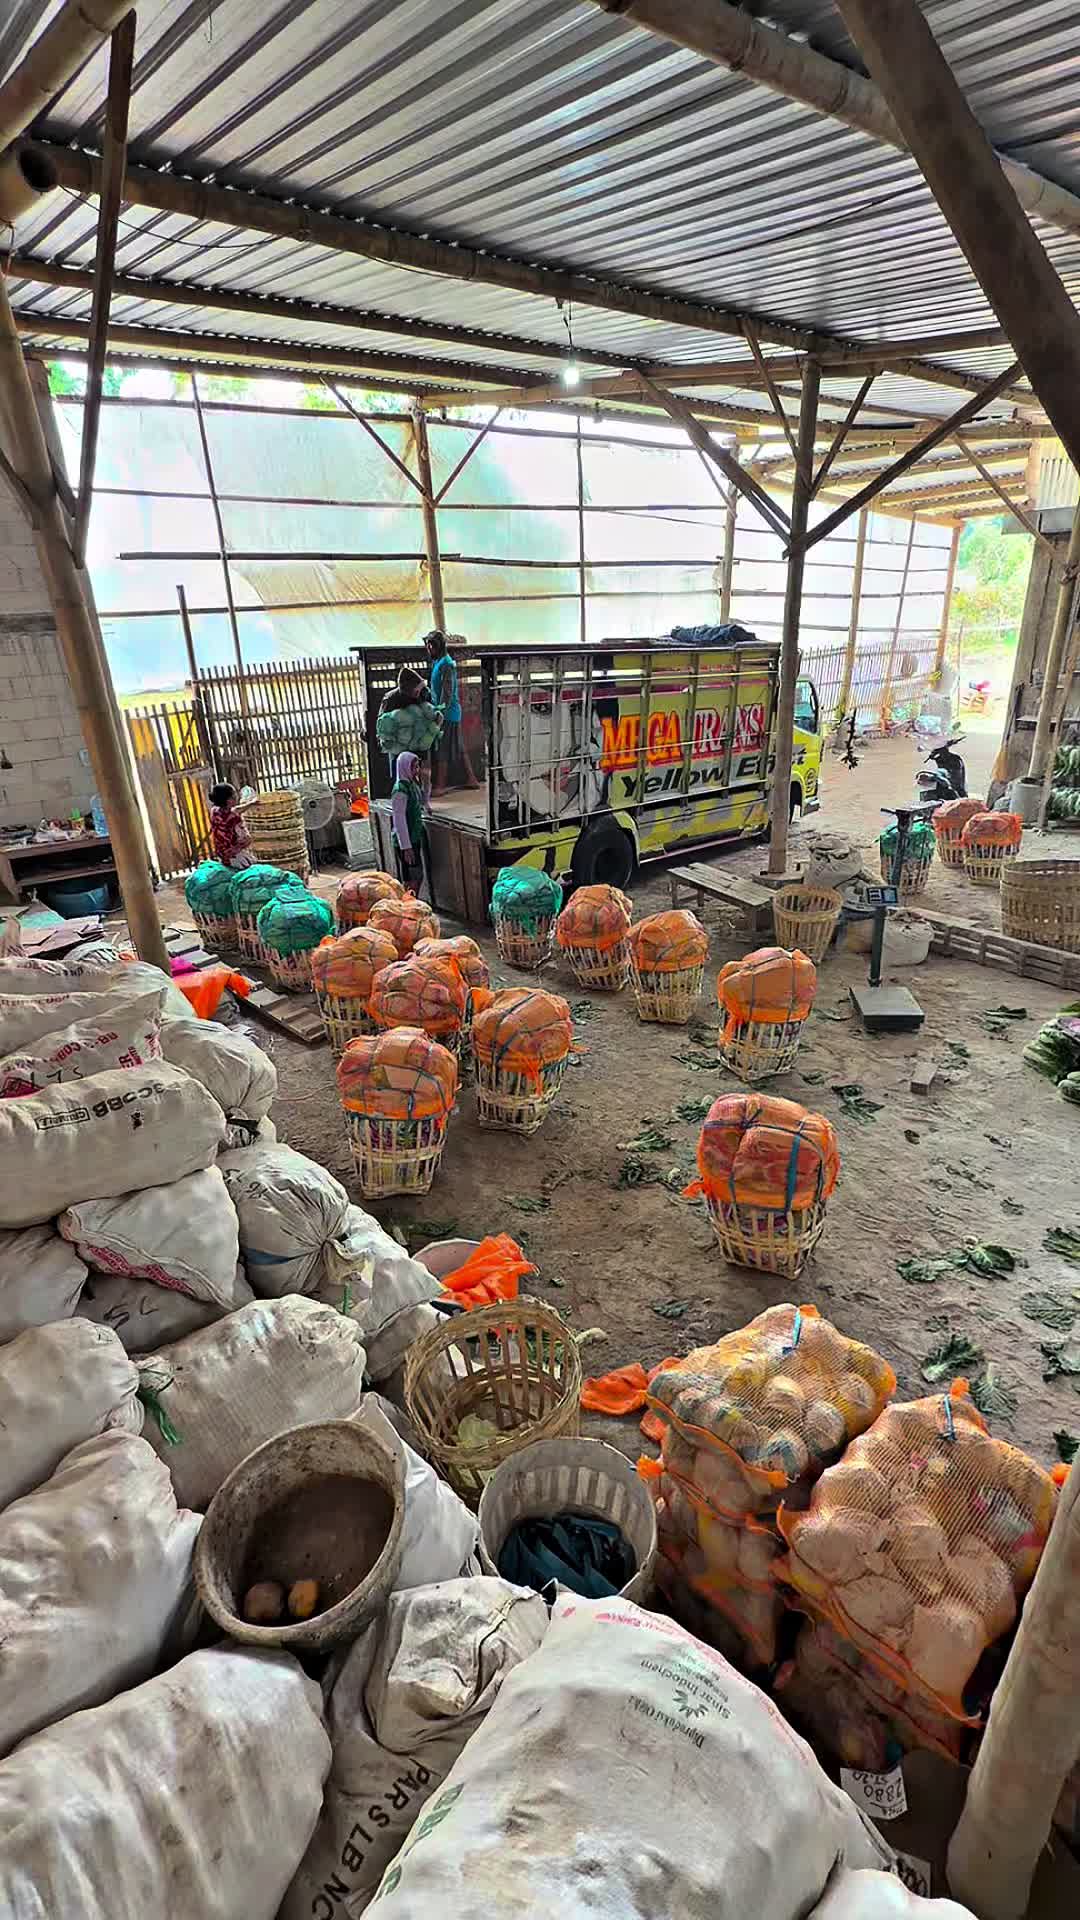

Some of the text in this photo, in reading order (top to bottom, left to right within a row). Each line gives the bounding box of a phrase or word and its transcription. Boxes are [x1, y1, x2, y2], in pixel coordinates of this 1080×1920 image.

[621, 766, 725, 798] Yellow
[698, 1691, 732, 1720] Sinar
[655, 1710, 705, 1749] Diproduksi
